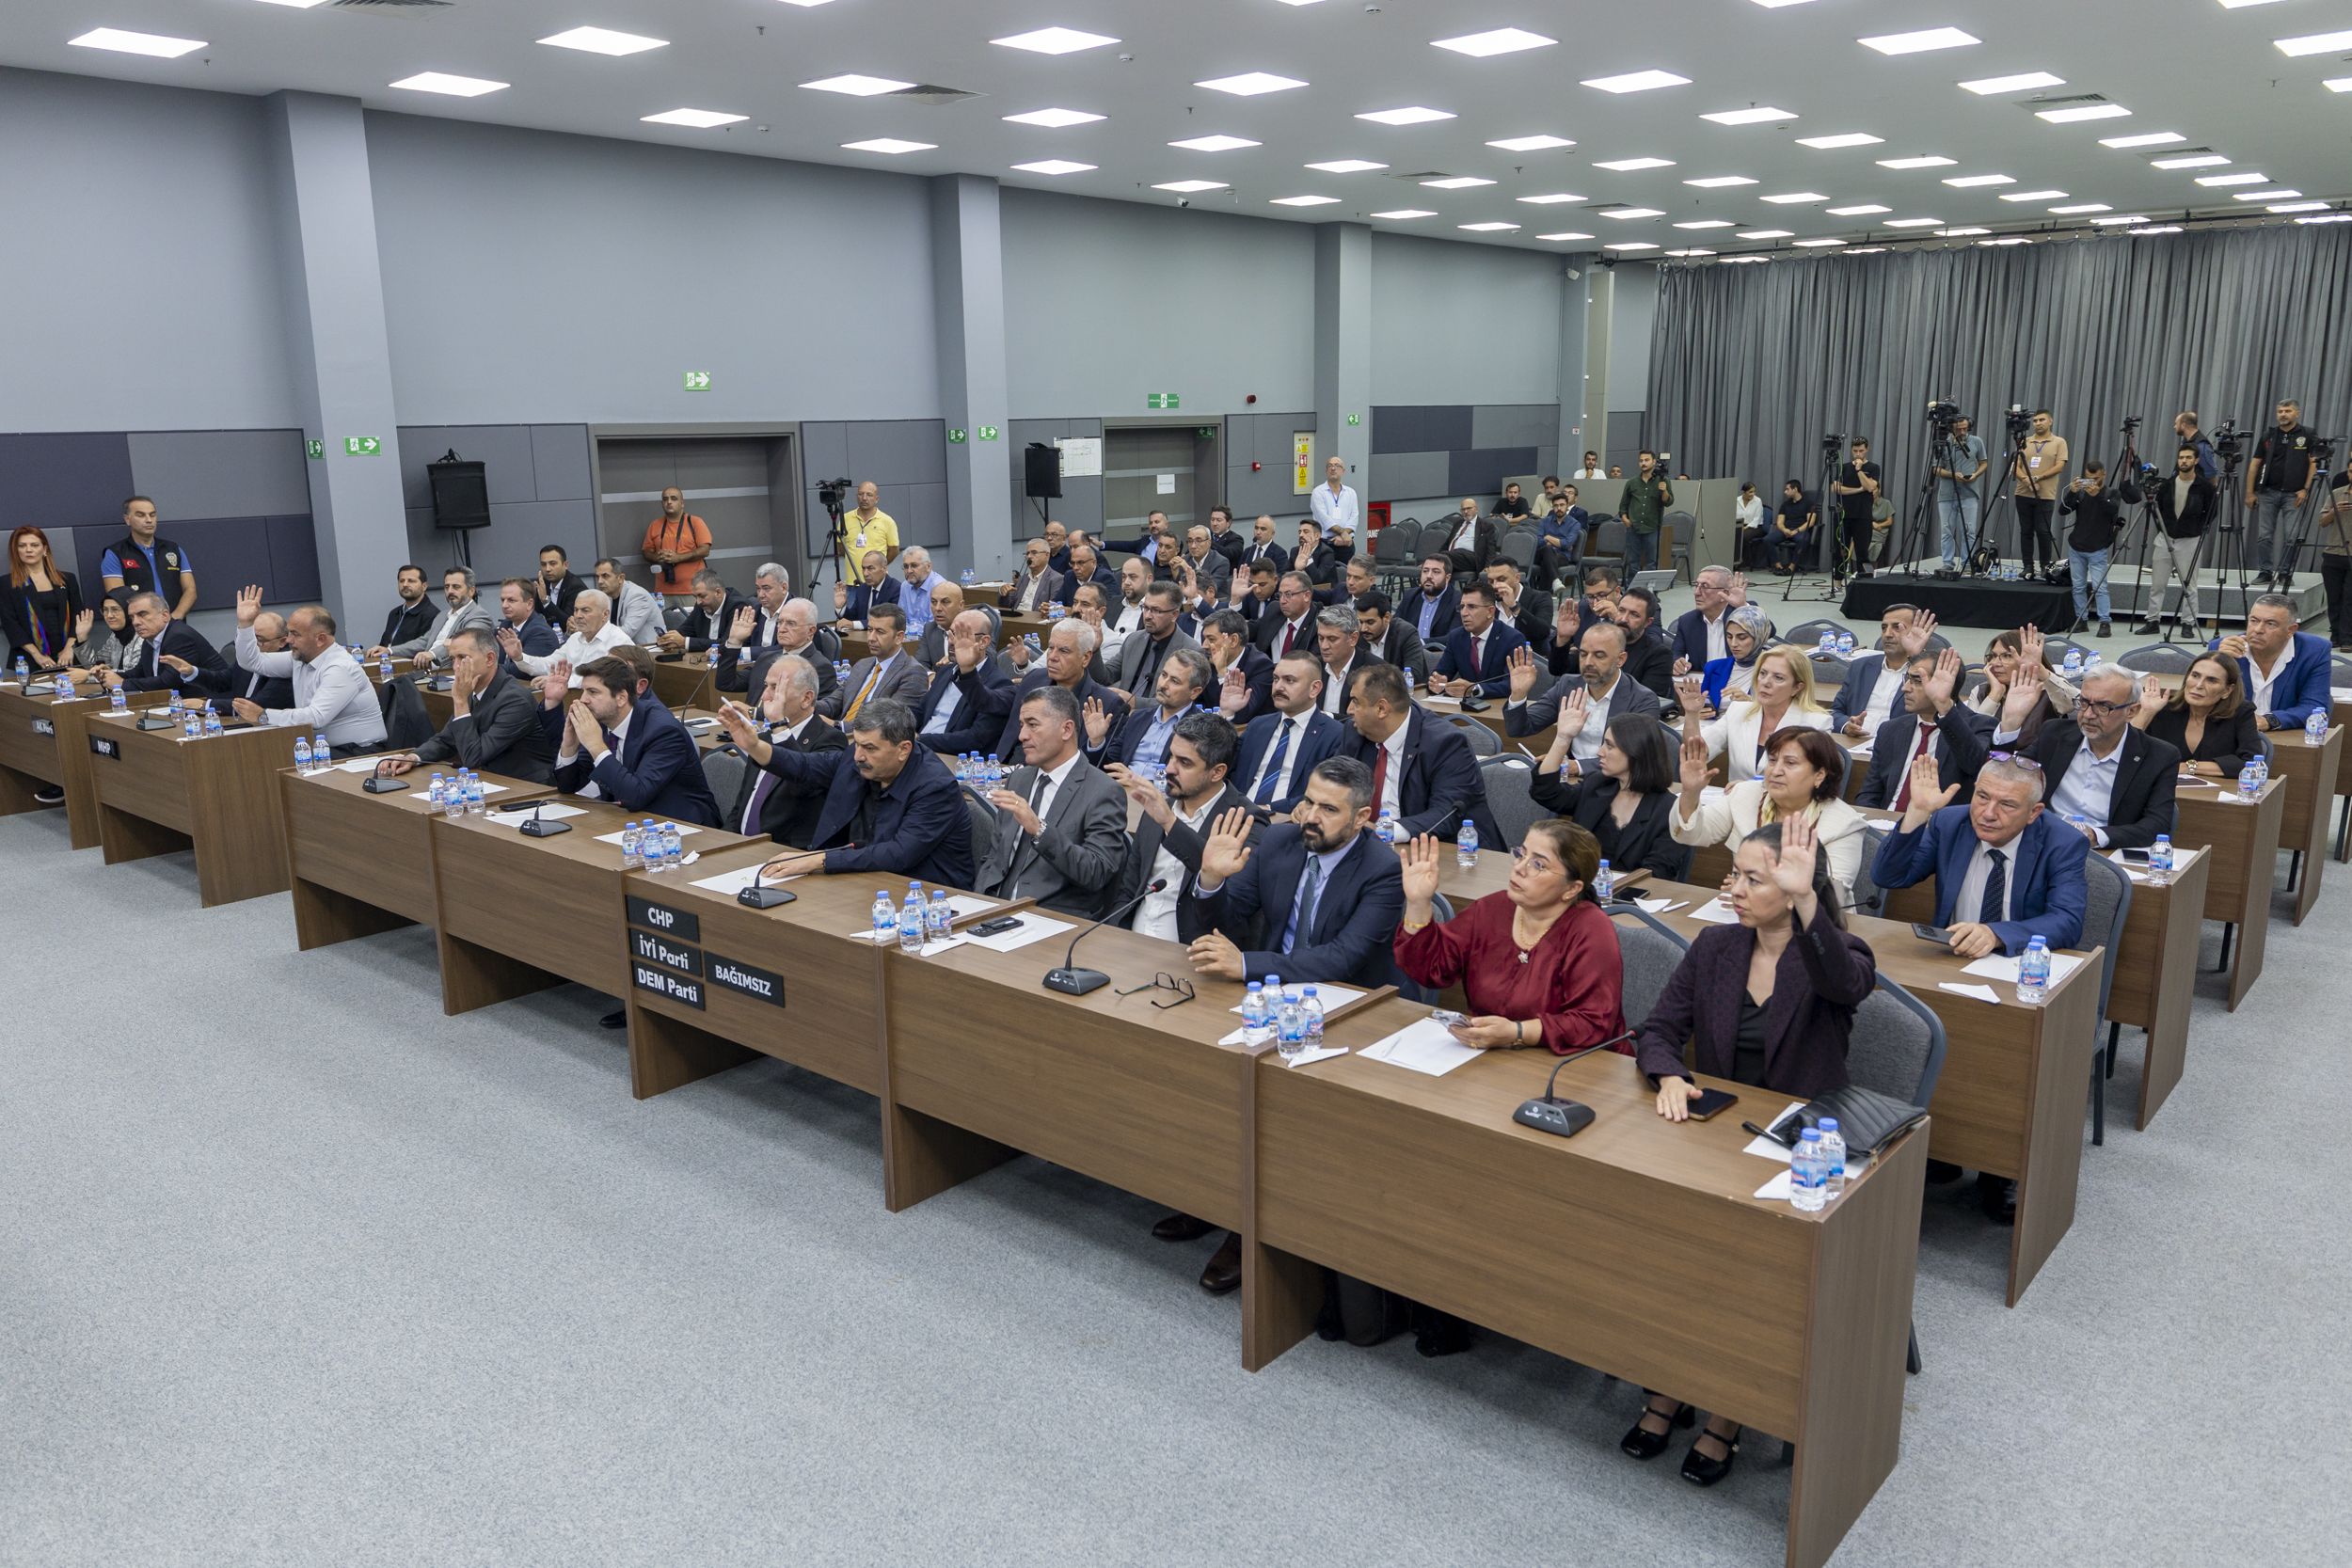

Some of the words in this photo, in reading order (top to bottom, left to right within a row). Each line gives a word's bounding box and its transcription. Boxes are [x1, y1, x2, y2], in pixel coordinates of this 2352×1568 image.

[97, 740, 111, 753] MHP
[647, 907, 674, 928] CHP
[640, 934, 656, 958] İYİ
[660, 945, 689, 970] Parti
[638, 968, 664, 991] DEM
[668, 978, 697, 1003] Parti
[715, 965, 771, 996] BAĞIMSIZ
